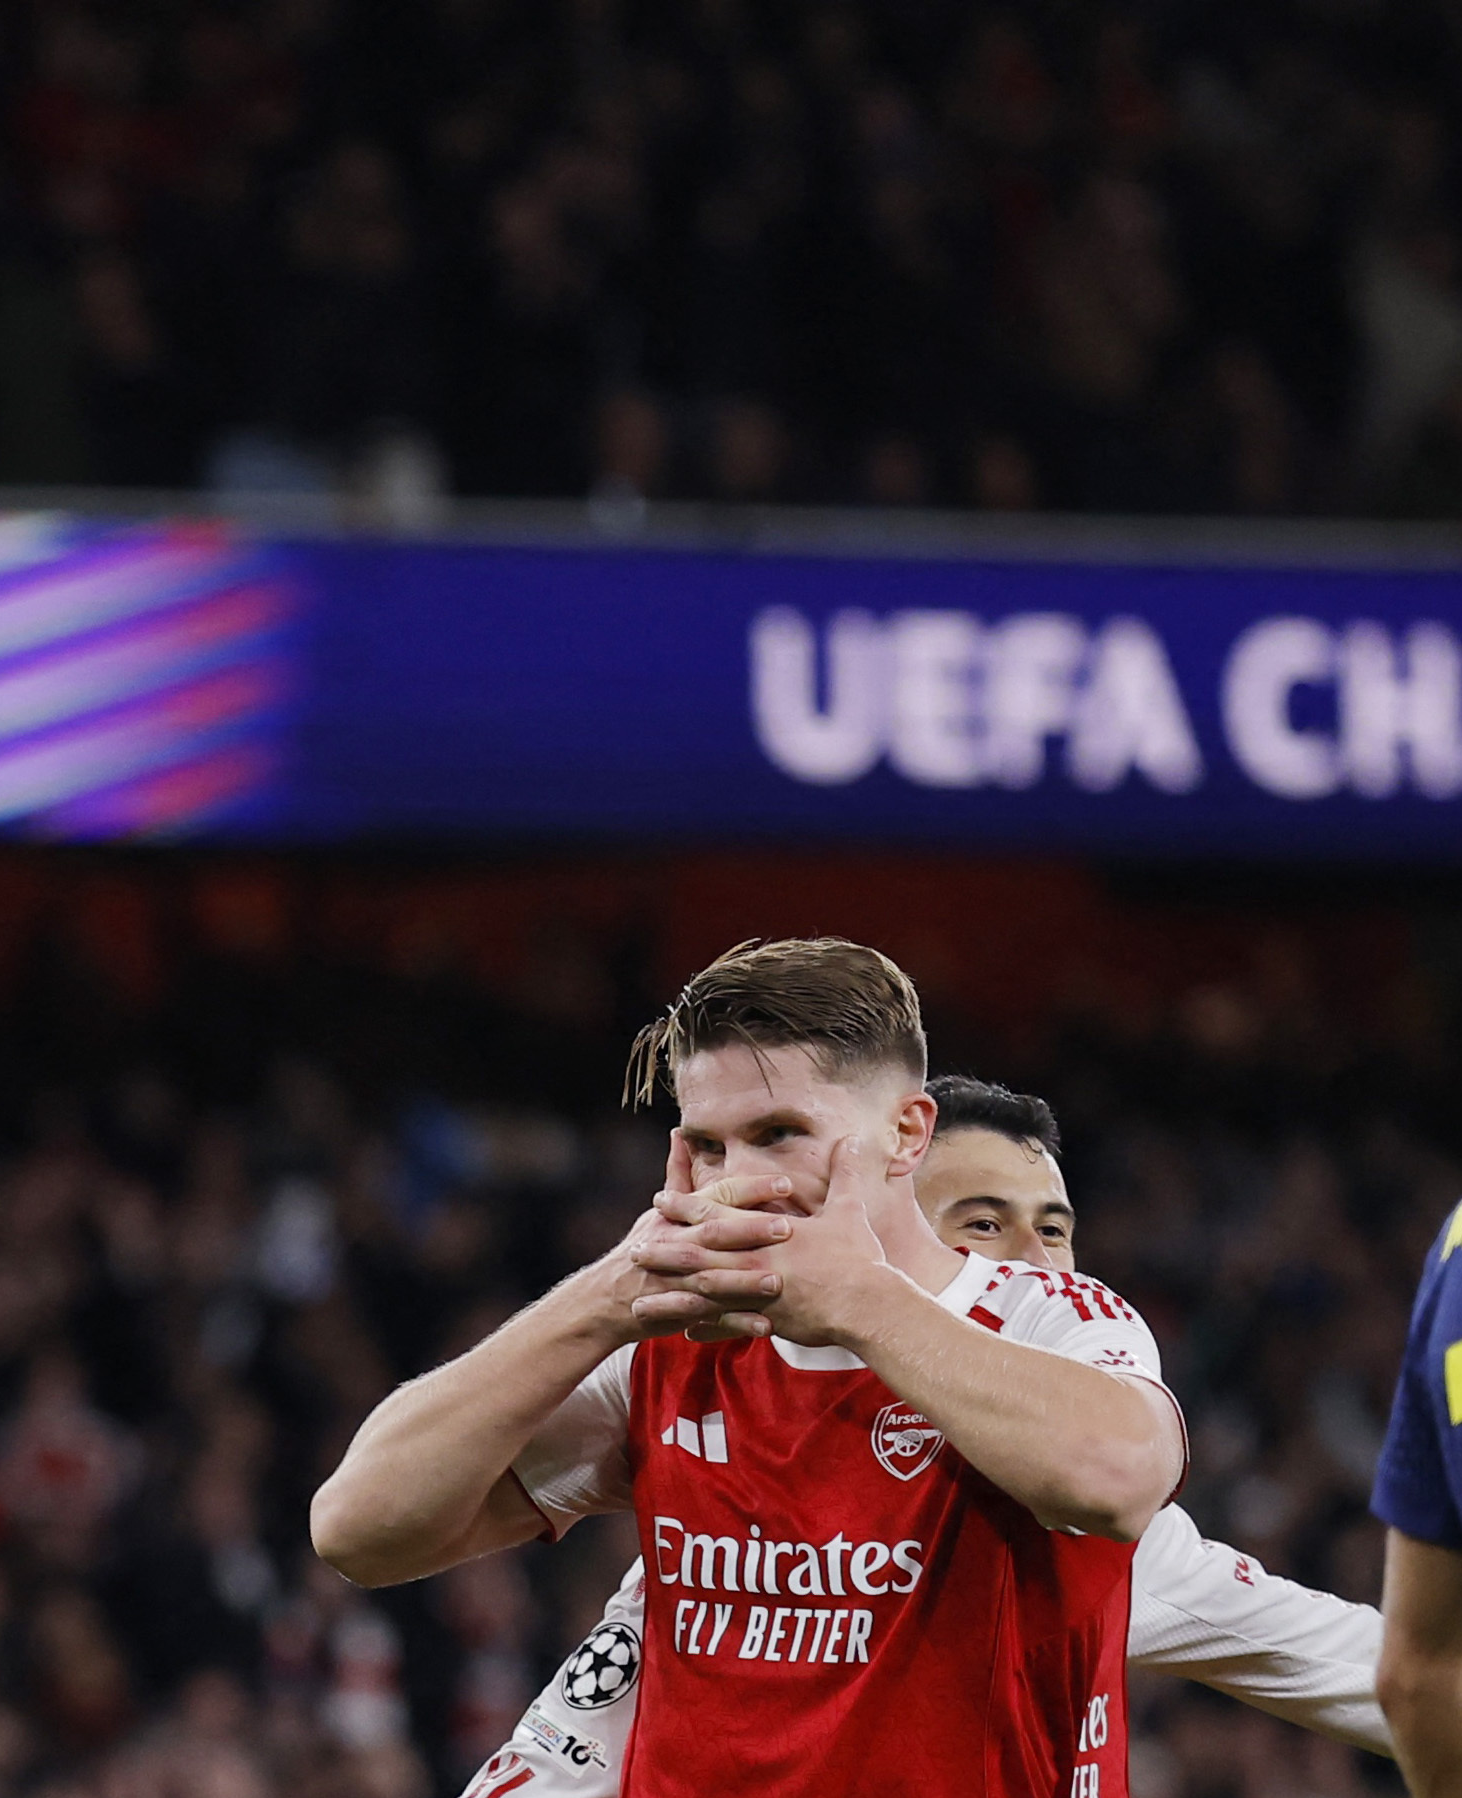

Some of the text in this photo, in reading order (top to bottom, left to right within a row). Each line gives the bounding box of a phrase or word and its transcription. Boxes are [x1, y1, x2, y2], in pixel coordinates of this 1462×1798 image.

[748, 606, 1200, 794] UEFA
[653, 1516, 923, 1596] Emirates
[675, 1600, 874, 1664] FLY BETTER
